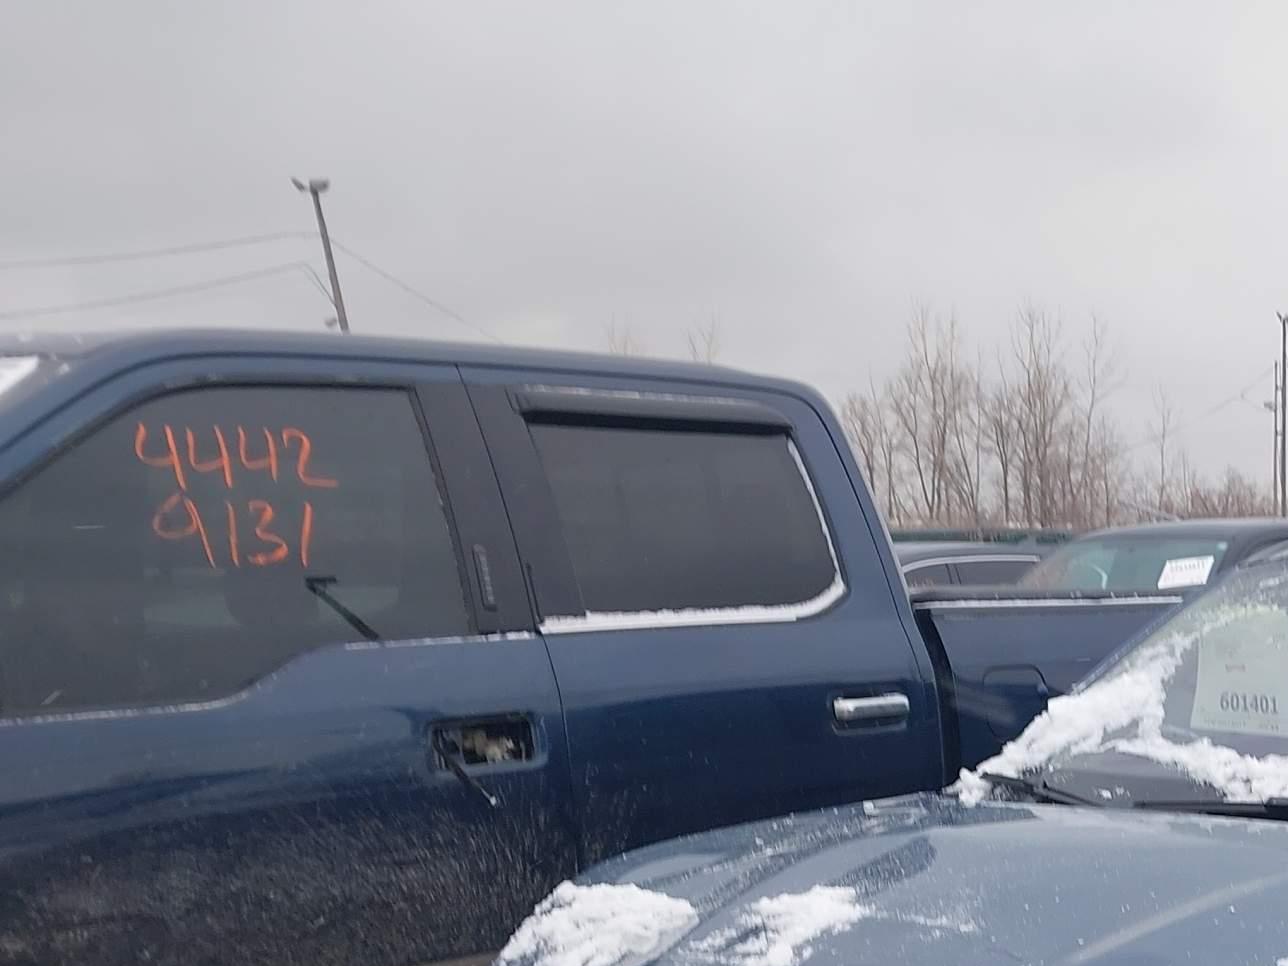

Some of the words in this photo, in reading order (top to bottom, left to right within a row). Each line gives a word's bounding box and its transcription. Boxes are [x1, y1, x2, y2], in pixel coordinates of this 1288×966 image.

[134, 421, 339, 490] 4442
[151, 489, 313, 569] 9131
[1220, 691, 1278, 715] 601401
